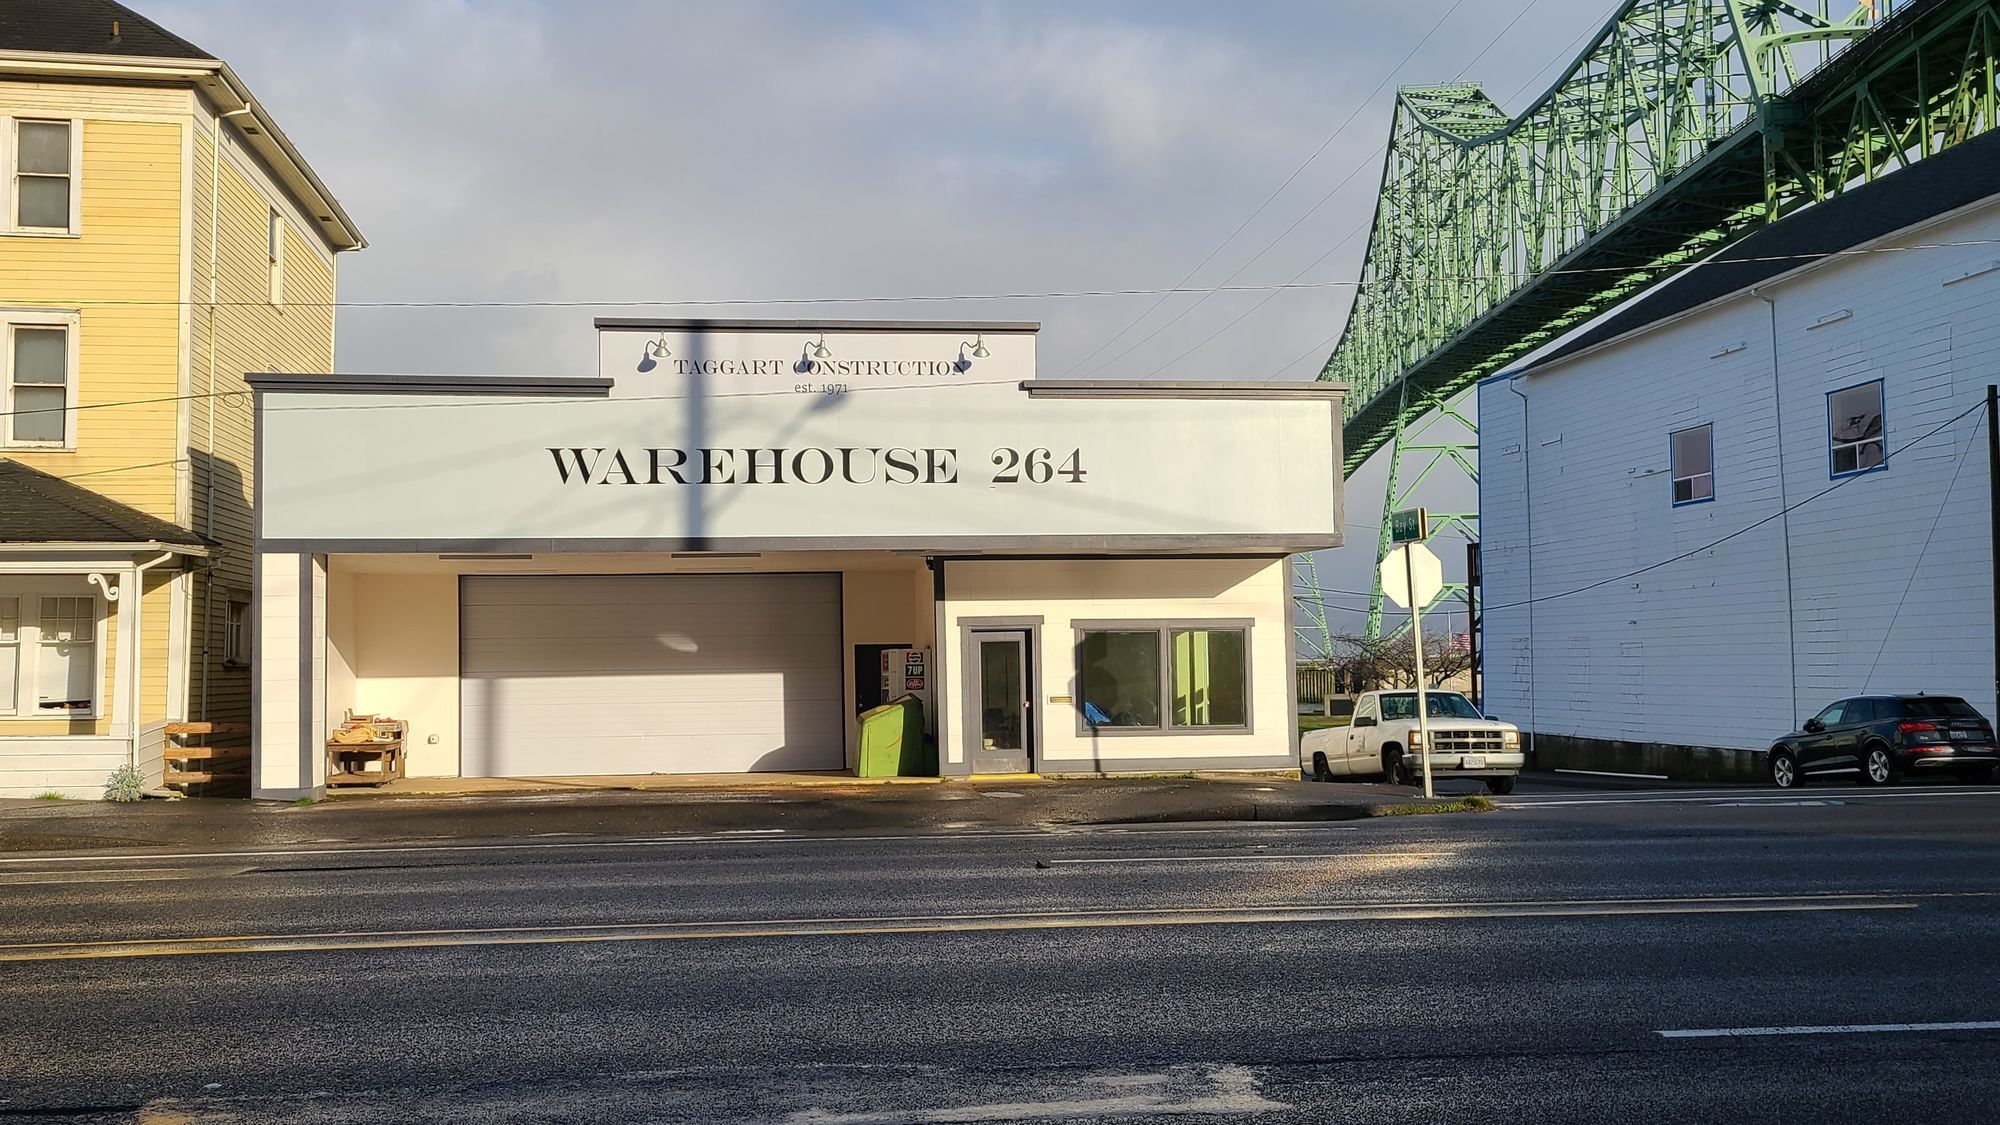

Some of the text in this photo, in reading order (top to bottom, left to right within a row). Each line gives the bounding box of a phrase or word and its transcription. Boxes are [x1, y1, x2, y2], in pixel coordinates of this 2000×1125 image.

[673, 359, 966, 376] TAGGART CONSTRUCTION
[794, 382, 848, 395] est. 1971
[545, 447, 1087, 485] WAREHOUSE 264
[1395, 516, 1416, 536] Bay St
